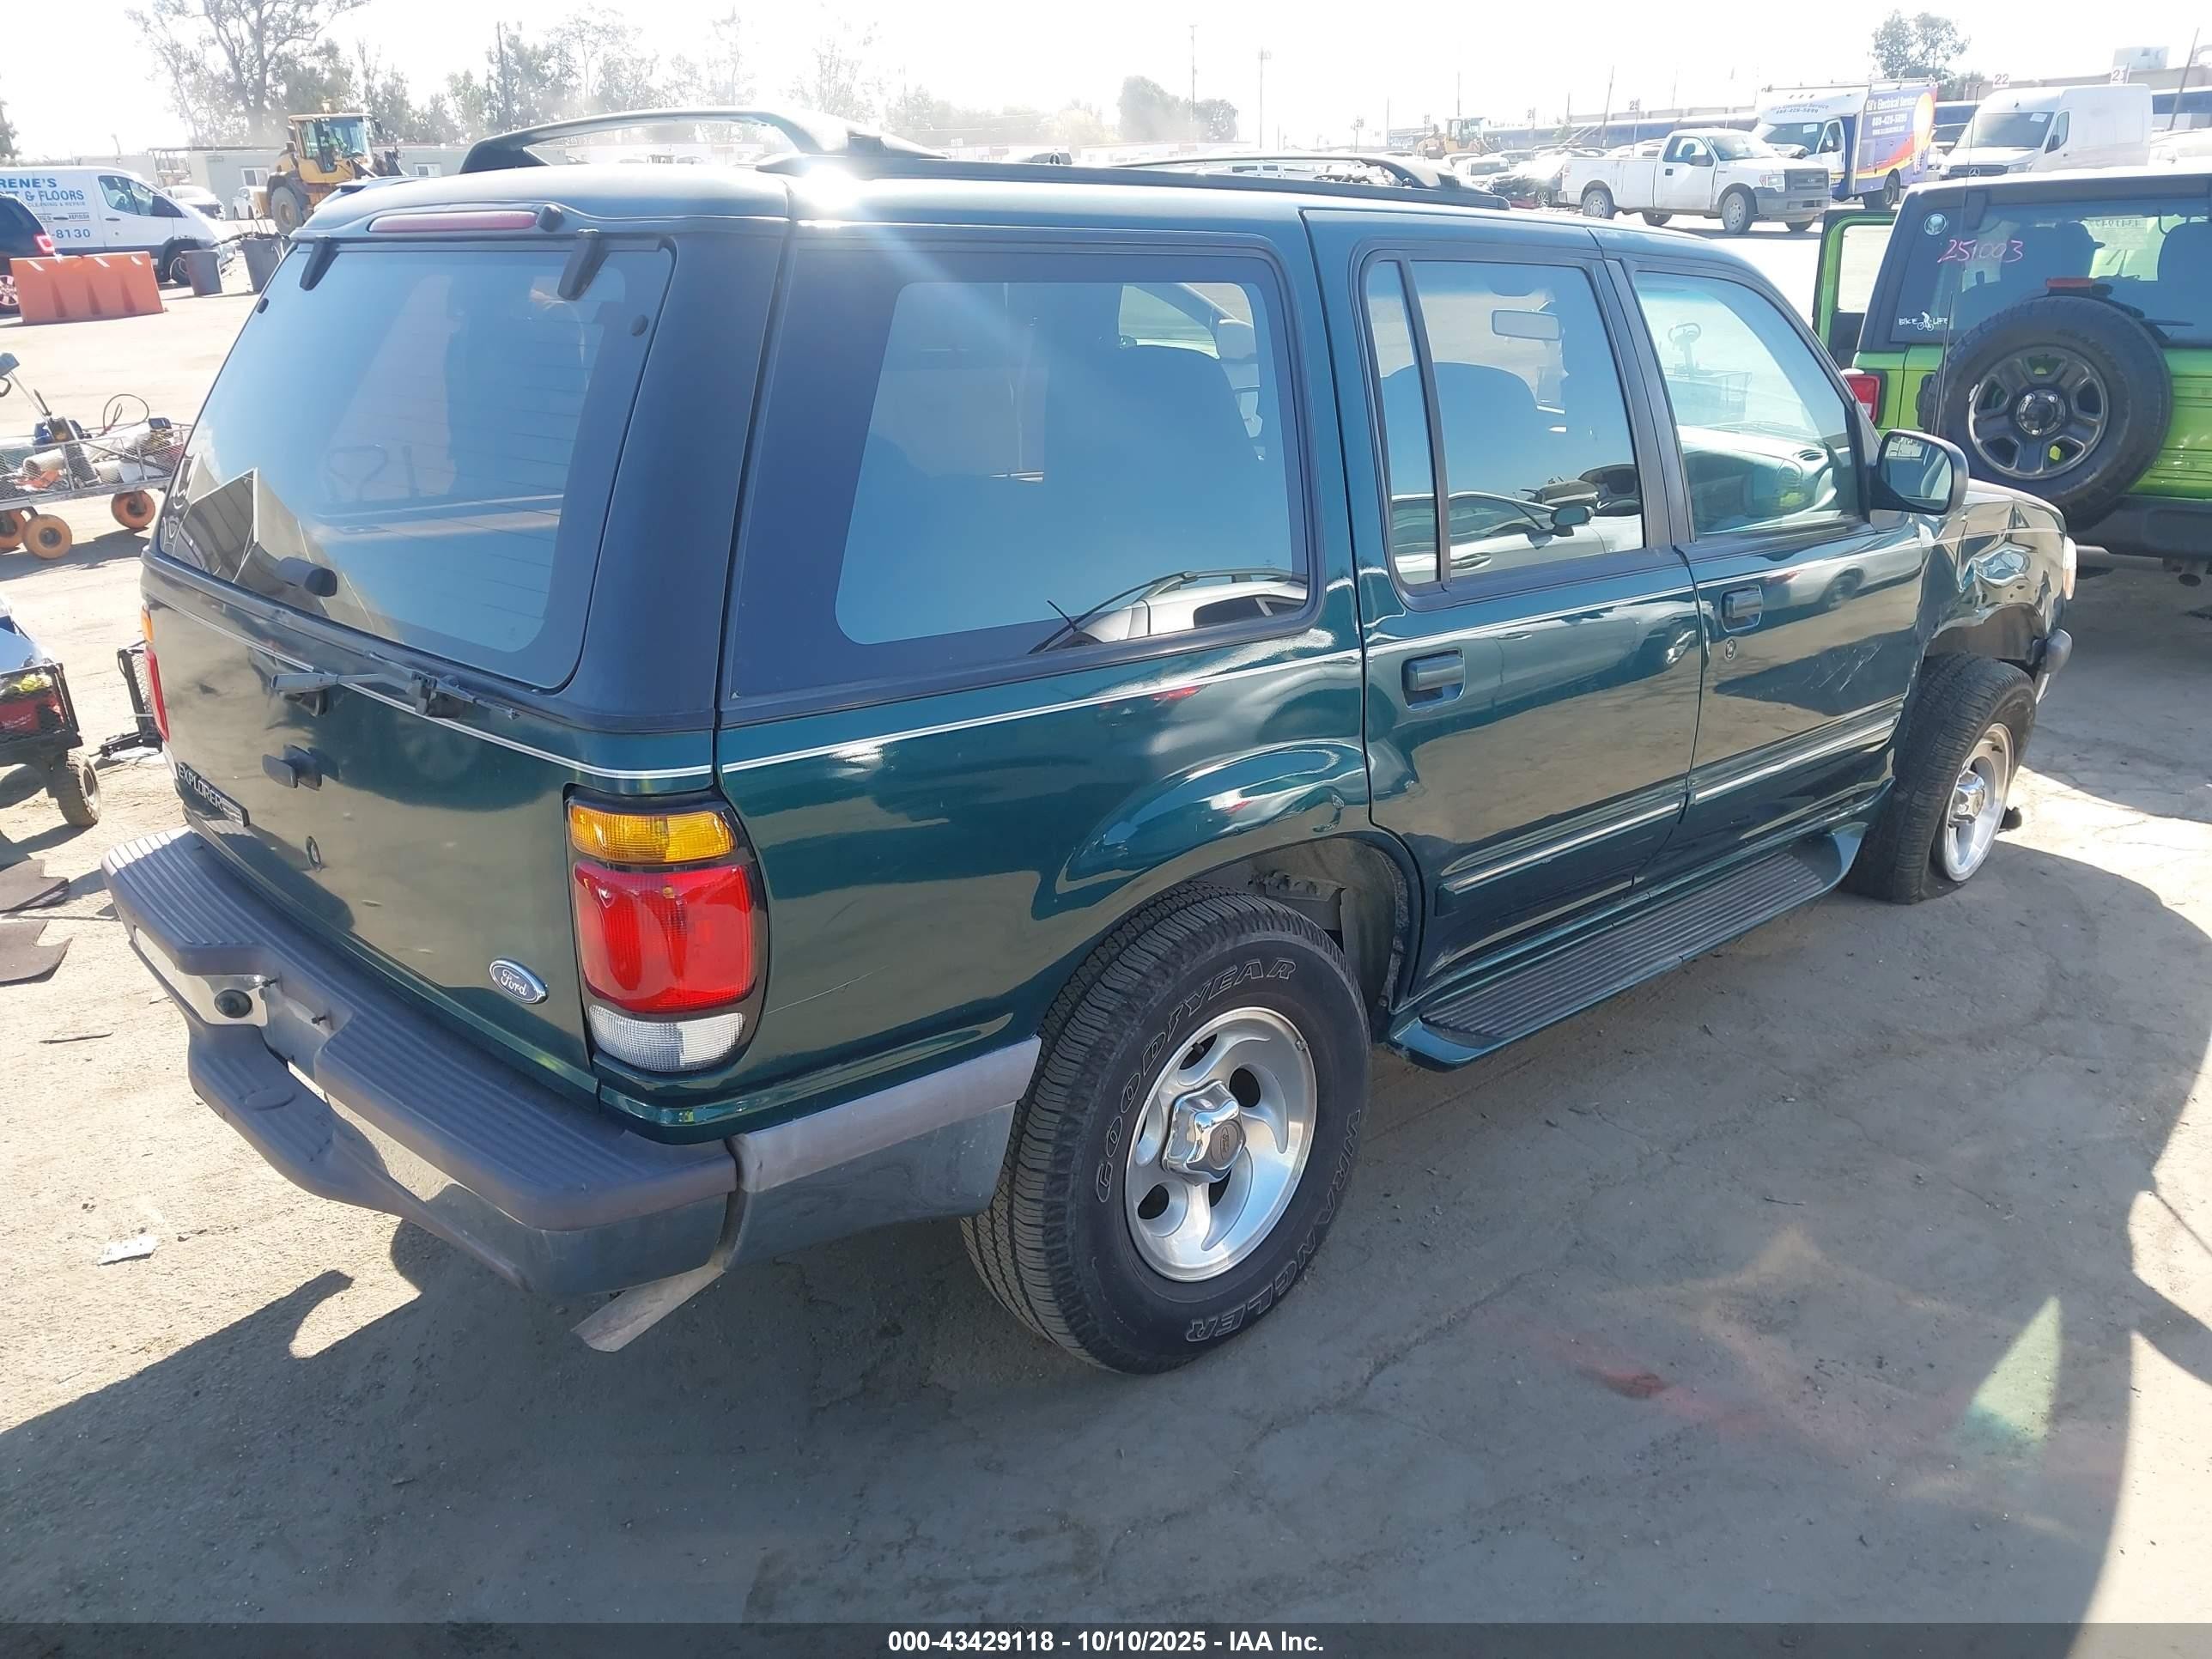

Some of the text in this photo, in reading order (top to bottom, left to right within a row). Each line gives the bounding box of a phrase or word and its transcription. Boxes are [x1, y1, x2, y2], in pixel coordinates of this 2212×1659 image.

[1994, 74, 2009, 85] 22
[25, 191, 35, 201] &
[38, 190, 84, 201] FLOORS
[1933, 317, 1948, 325] LIFE
[178, 763, 224, 811] EXPLORER
[501, 969, 527, 996] Ford
[1095, 957, 1297, 1203] GOODYEAR
[1185, 1108, 1361, 1342] WRANGLER
